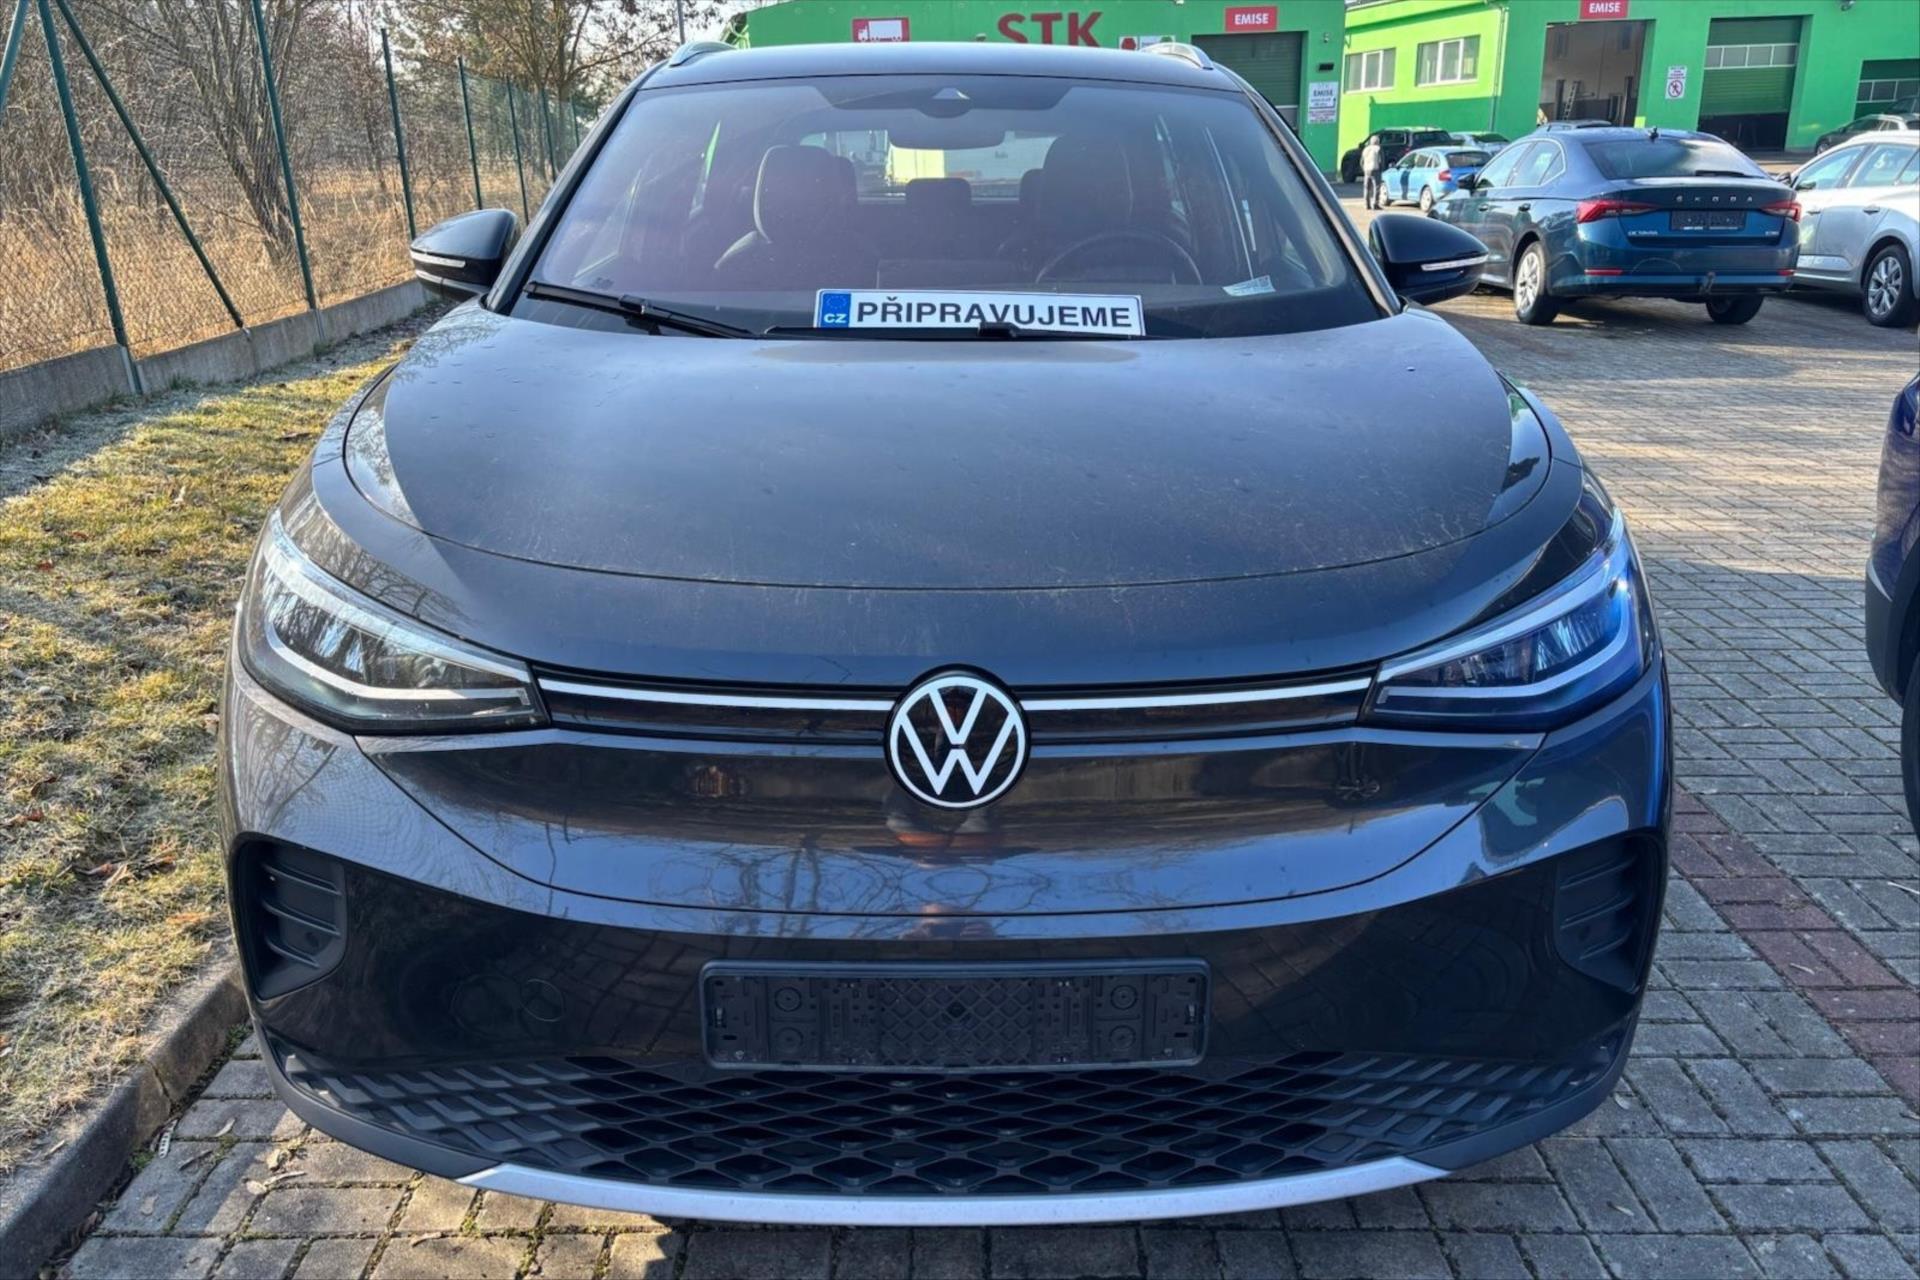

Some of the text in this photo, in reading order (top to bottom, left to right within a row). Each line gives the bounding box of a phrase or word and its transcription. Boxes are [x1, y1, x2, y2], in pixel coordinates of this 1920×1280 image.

[1589, 2, 1621, 13] EMISE
[998, 11, 1103, 48] STK
[1234, 13, 1269, 25] EMISE
[823, 312, 847, 324] CZ
[857, 296, 1132, 328] PŘIPRAVUJEME
[894, 681, 1022, 798] VW
